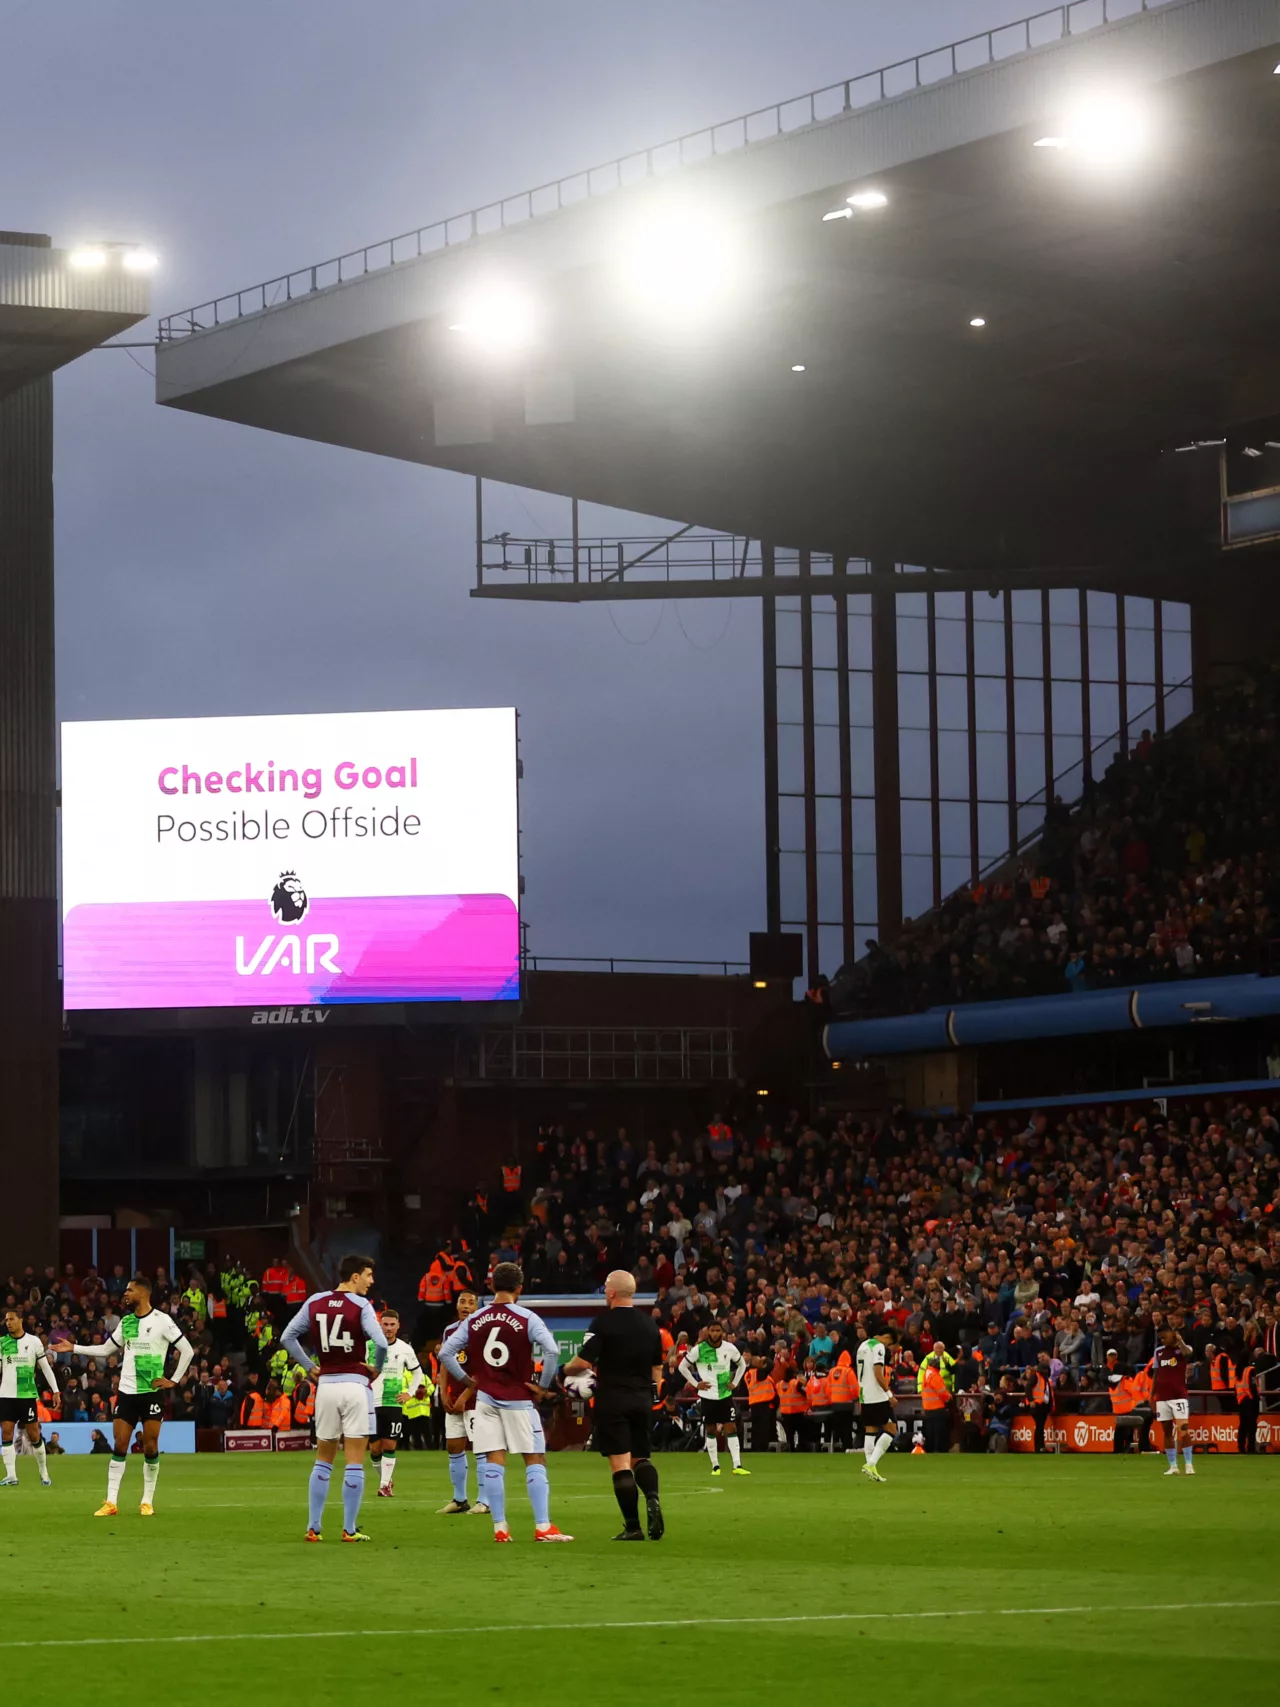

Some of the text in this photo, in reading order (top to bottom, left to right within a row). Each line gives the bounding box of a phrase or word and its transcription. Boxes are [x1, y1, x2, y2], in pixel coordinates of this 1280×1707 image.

[158, 757, 418, 799] Checking Goal
[157, 805, 422, 843] Possible Offside
[235, 933, 343, 975] VAR
[251, 1006, 331, 1025] adi.tv
[328, 1299, 344, 1308] PAU
[471, 1312, 524, 1332] DOUGLAS LUIZ
[315, 1313, 355, 1354] 14
[483, 1326, 509, 1368] 6
[558, 1339, 583, 1355] Fir
[858, 1359, 865, 1382] 7
[28, 1407, 35, 1418] 4
[730, 1407, 736, 1417] 2
[1176, 1402, 1186, 1412] 31
[390, 1422, 402, 1435] 10
[1010, 1426, 1032, 1441] rade
[1042, 1426, 1067, 1442] ation
[1212, 1426, 1239, 1441] Natio
